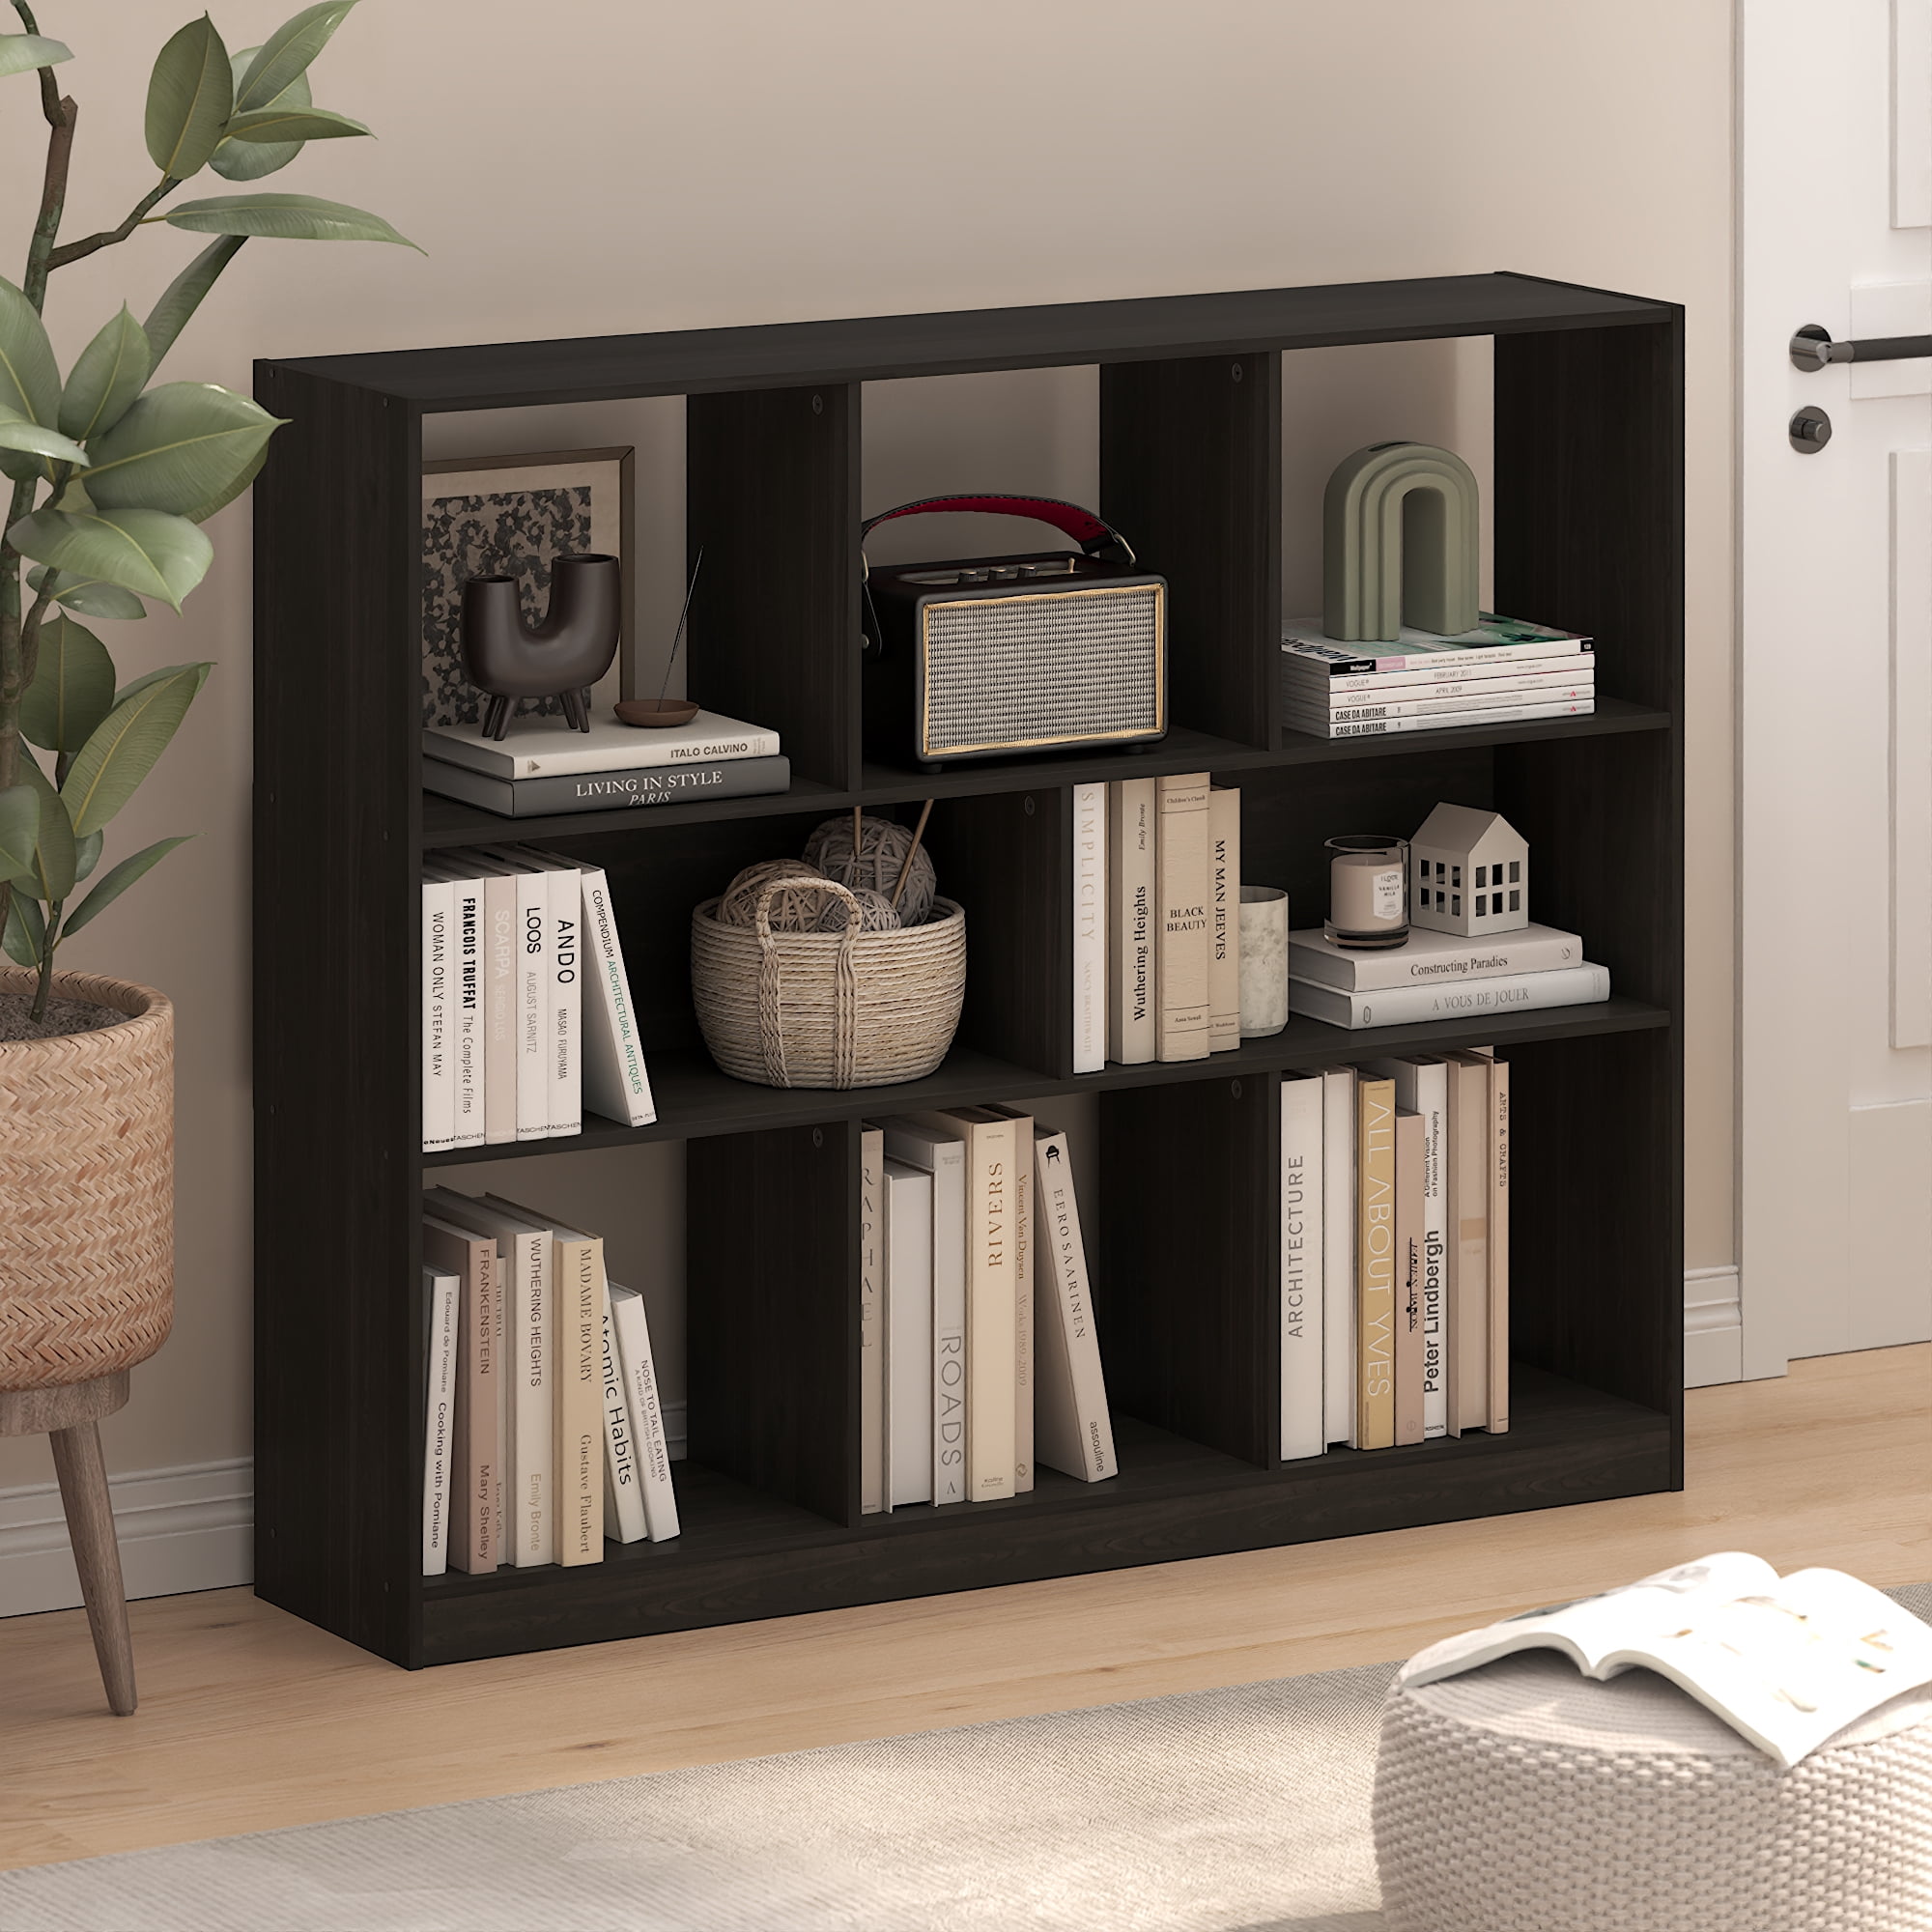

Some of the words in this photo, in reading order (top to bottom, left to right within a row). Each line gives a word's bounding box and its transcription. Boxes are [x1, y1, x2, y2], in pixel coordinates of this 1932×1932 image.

[1450, 685, 1463, 694] 2009
[1335, 709, 1351, 721] CASE
[1351, 708, 1360, 719] DA
[1361, 706, 1387, 718] ABITARE
[1335, 724, 1351, 736] CASE
[1351, 724, 1360, 734] DA
[1361, 722, 1387, 733] ABITARE
[670, 747, 701, 759] ITALO
[703, 743, 749, 756] CALVINO
[576, 779, 639, 797] LIVING
[643, 776, 663, 790] IN
[667, 771, 724, 788] STYLE
[629, 791, 671, 806] PARIS
[1081, 792, 1094, 942] SIMPLICITY
[1215, 839, 1226, 862] MY
[1215, 868, 1226, 901] MAN
[463, 897, 475, 958] FRANCOIS
[526, 907, 541, 954] LOOS
[1133, 886, 1149, 941] Heights
[1167, 920, 1208, 932] BEAUTY
[1170, 906, 1205, 919] BLACK
[1215, 906, 1226, 960] JEEVES
[433, 911, 444, 962] WOMAN
[495, 909, 510, 980] SCARPA
[557, 919, 575, 983] ANDO
[433, 966, 444, 1000] ONLY
[463, 959, 476, 1009] TRUFFAT
[1133, 946, 1149, 1020] Wuthering
[1410, 960, 1468, 977] Constructing
[1470, 955, 1508, 970] Paradies
[526, 972, 536, 1009] AUGUST
[592, 890, 614, 957] COMPENDIUM
[608, 960, 631, 1041] ARCHITECTURAL
[625, 1044, 643, 1094] ANTIQUES
[1432, 998, 1439, 1011] A
[1444, 994, 1473, 1009] VOUS
[1477, 992, 1492, 1006] DE
[1494, 987, 1530, 1006] JOUER
[433, 1005, 442, 1049] STEFAN
[463, 1015, 473, 1035] The
[526, 1011, 537, 1053] SARNITZ
[557, 1009, 567, 1036] MASAO
[433, 1054, 441, 1077] MAY
[462, 1037, 473, 1085] Complete
[557, 1039, 568, 1080] FURUYAMA
[463, 1088, 472, 1114] Films
[1368, 1100, 1391, 1163] ALL
[1499, 1127, 1507, 1137] &
[1018, 1174, 1028, 1214] Vincent
[1432, 1187, 1437, 1197] on
[988, 1162, 1003, 1267] RIVERS
[1018, 1216, 1028, 1237] Van
[1368, 1176, 1391, 1294] ABOUT
[1015, 1240, 1028, 1280] Duysen
[1054, 1189, 1069, 1237] EERO
[1062, 1241, 1086, 1339] SAARINEN
[1288, 1155, 1303, 1339] ARCHITECTURE
[530, 1237, 542, 1322] WUTHERING
[580, 1248, 591, 1319] MADAME
[1424, 1230, 1443, 1333] Lindbergh
[480, 1249, 490, 1375] FRANKENSTEIN
[443, 1333, 450, 1346] de
[530, 1326, 542, 1387] HEIGHTS
[580, 1321, 592, 1384] BOVARY
[1368, 1312, 1391, 1397] YVES
[440, 1349, 450, 1393] Pomiane
[640, 1360, 653, 1393] NOSE
[1424, 1340, 1439, 1394] Peter
[646, 1394, 656, 1410] TO
[941, 1335, 962, 1466] ROADS
[436, 1402, 447, 1456] Cooking
[609, 1406, 632, 1486] Habits
[640, 1410, 651, 1440] BRITISH
[646, 1442, 657, 1478] COOKING
[649, 1412, 660, 1437] TAIL
[580, 1435, 591, 1491] Gustave
[654, 1440, 667, 1483] EATING
[1089, 1421, 1104, 1473] assouline
[435, 1460, 443, 1489] with
[478, 1465, 490, 1501] Mary
[529, 1473, 541, 1508] Emily
[431, 1492, 442, 1549] Pomiane
[478, 1505, 490, 1560] Shelley
[530, 1510, 541, 1551] Bronte
[580, 1494, 590, 1553] Flaubert
